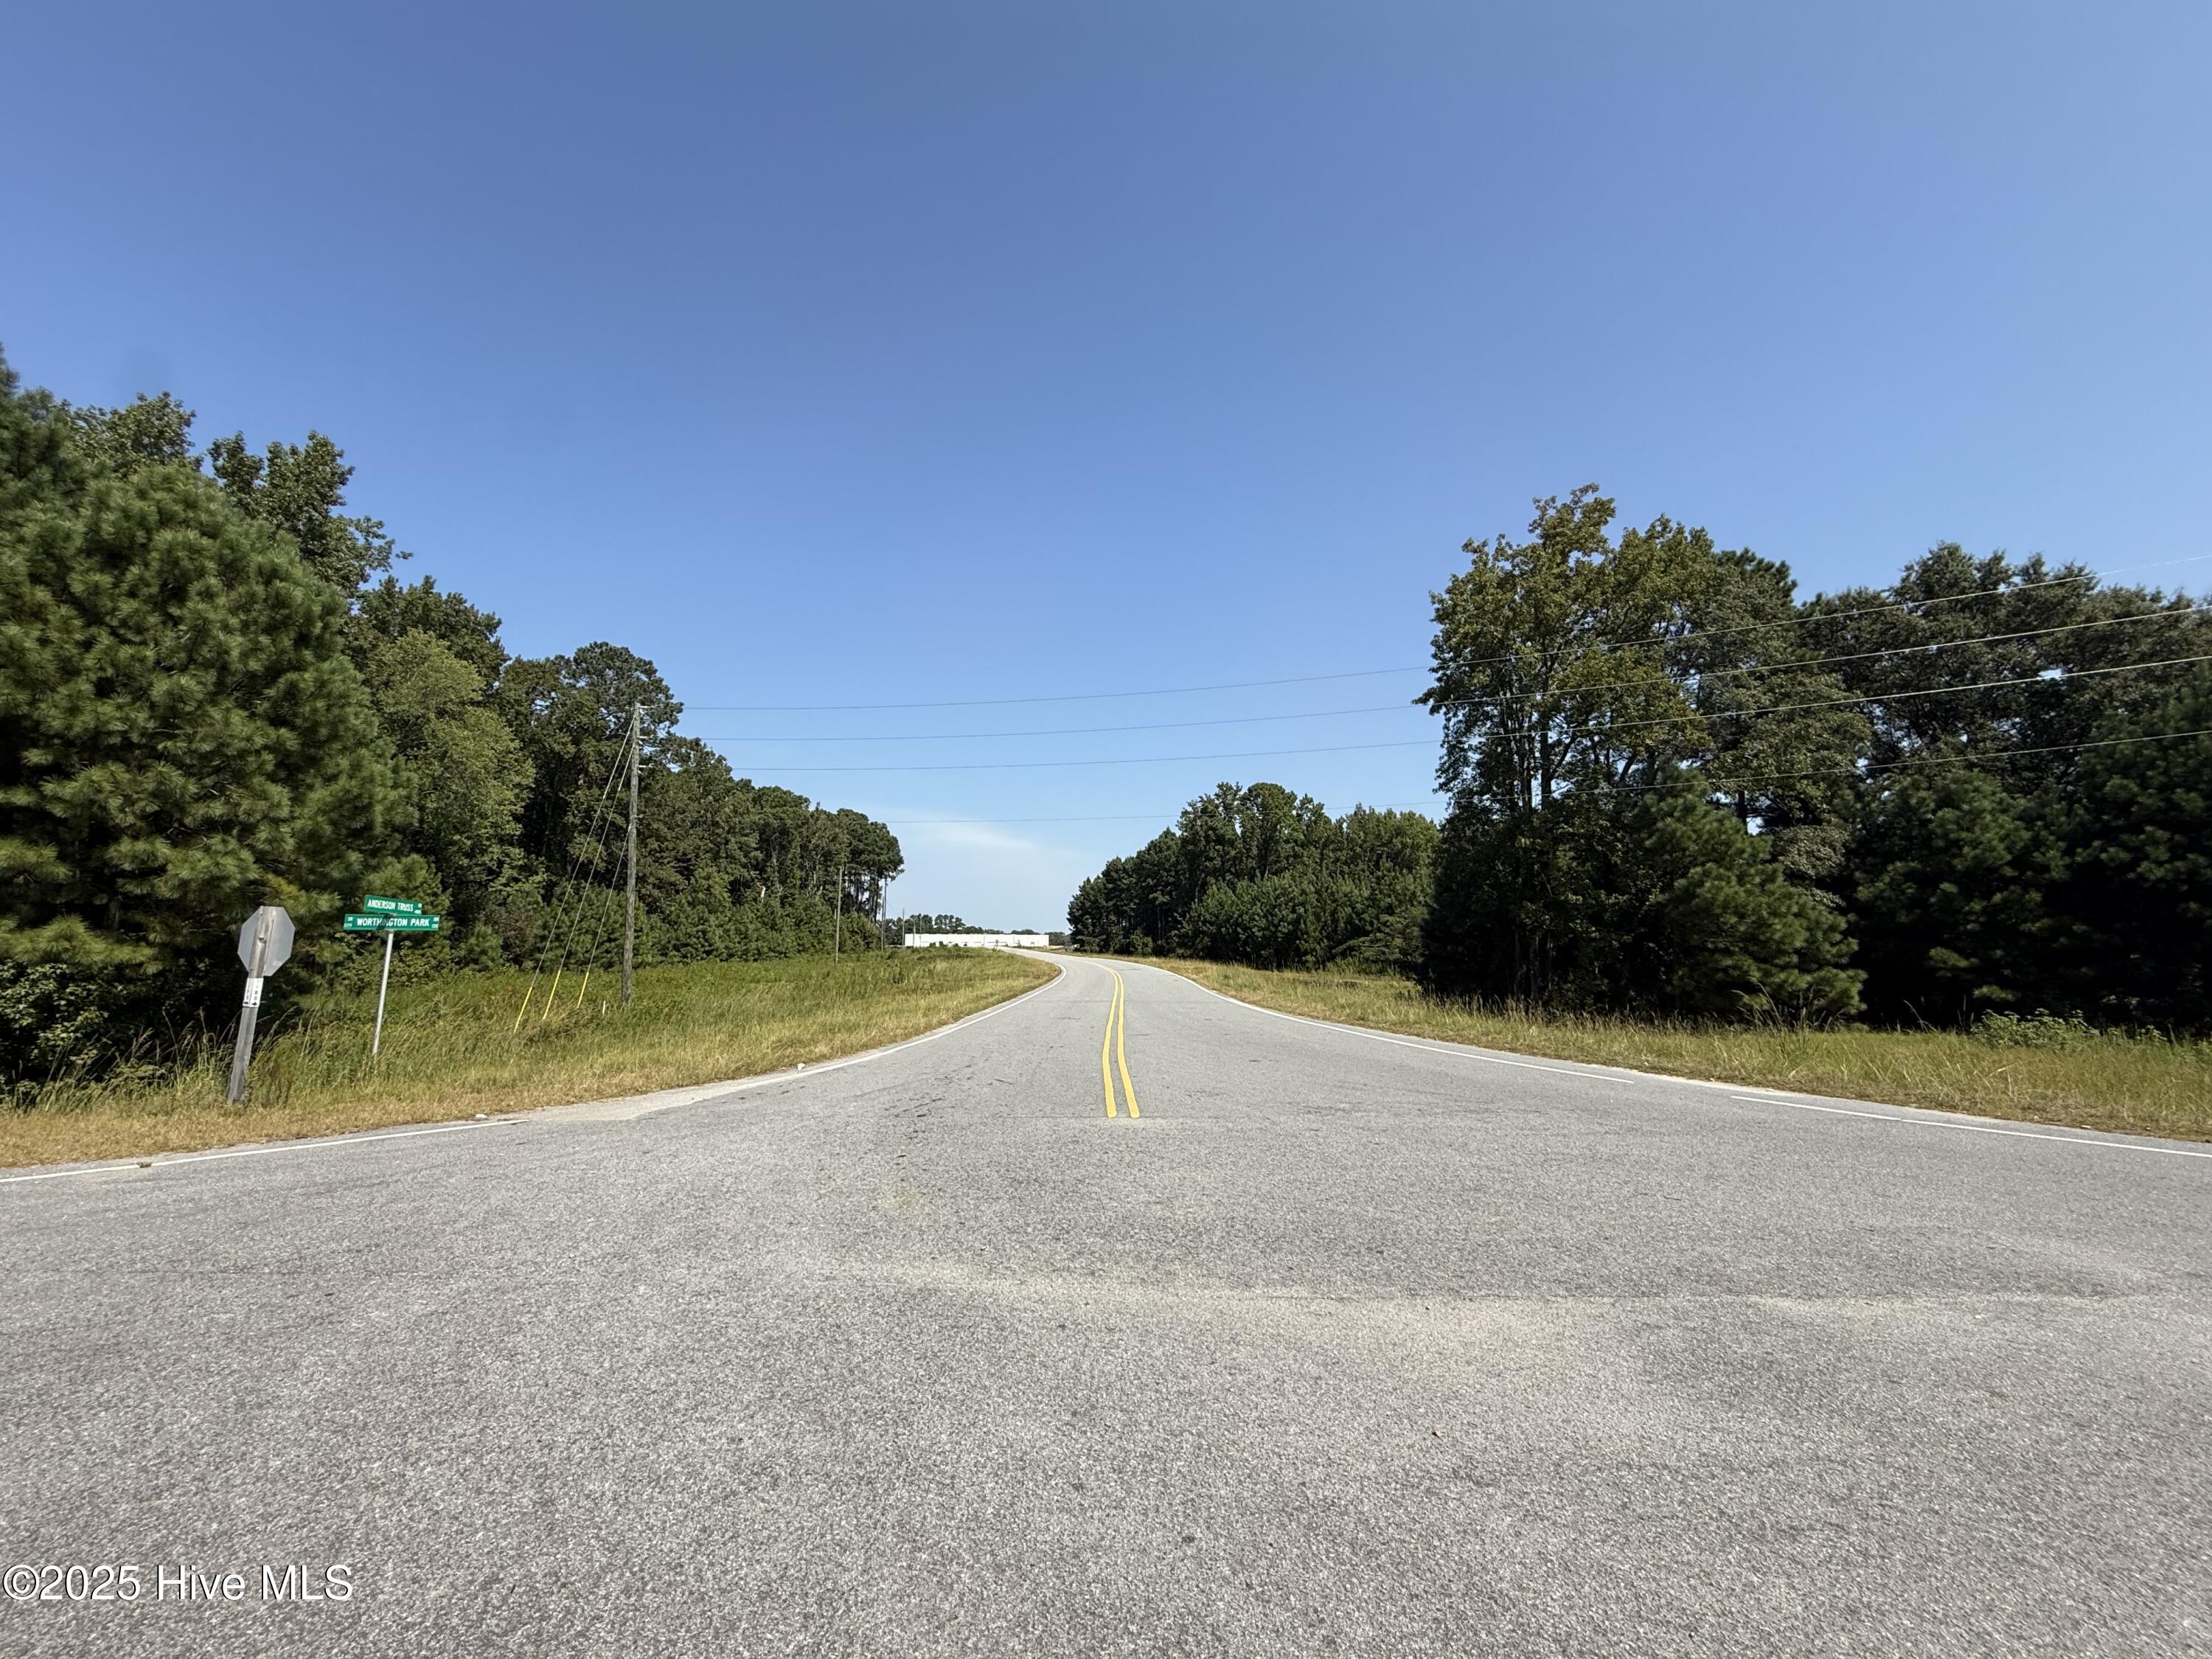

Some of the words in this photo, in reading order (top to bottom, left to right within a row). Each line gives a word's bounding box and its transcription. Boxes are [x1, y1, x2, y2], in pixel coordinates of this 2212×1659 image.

[367, 900, 395, 910] ANDERSON
[397, 902, 414, 912] TRUSS
[411, 918, 430, 926] PARK
